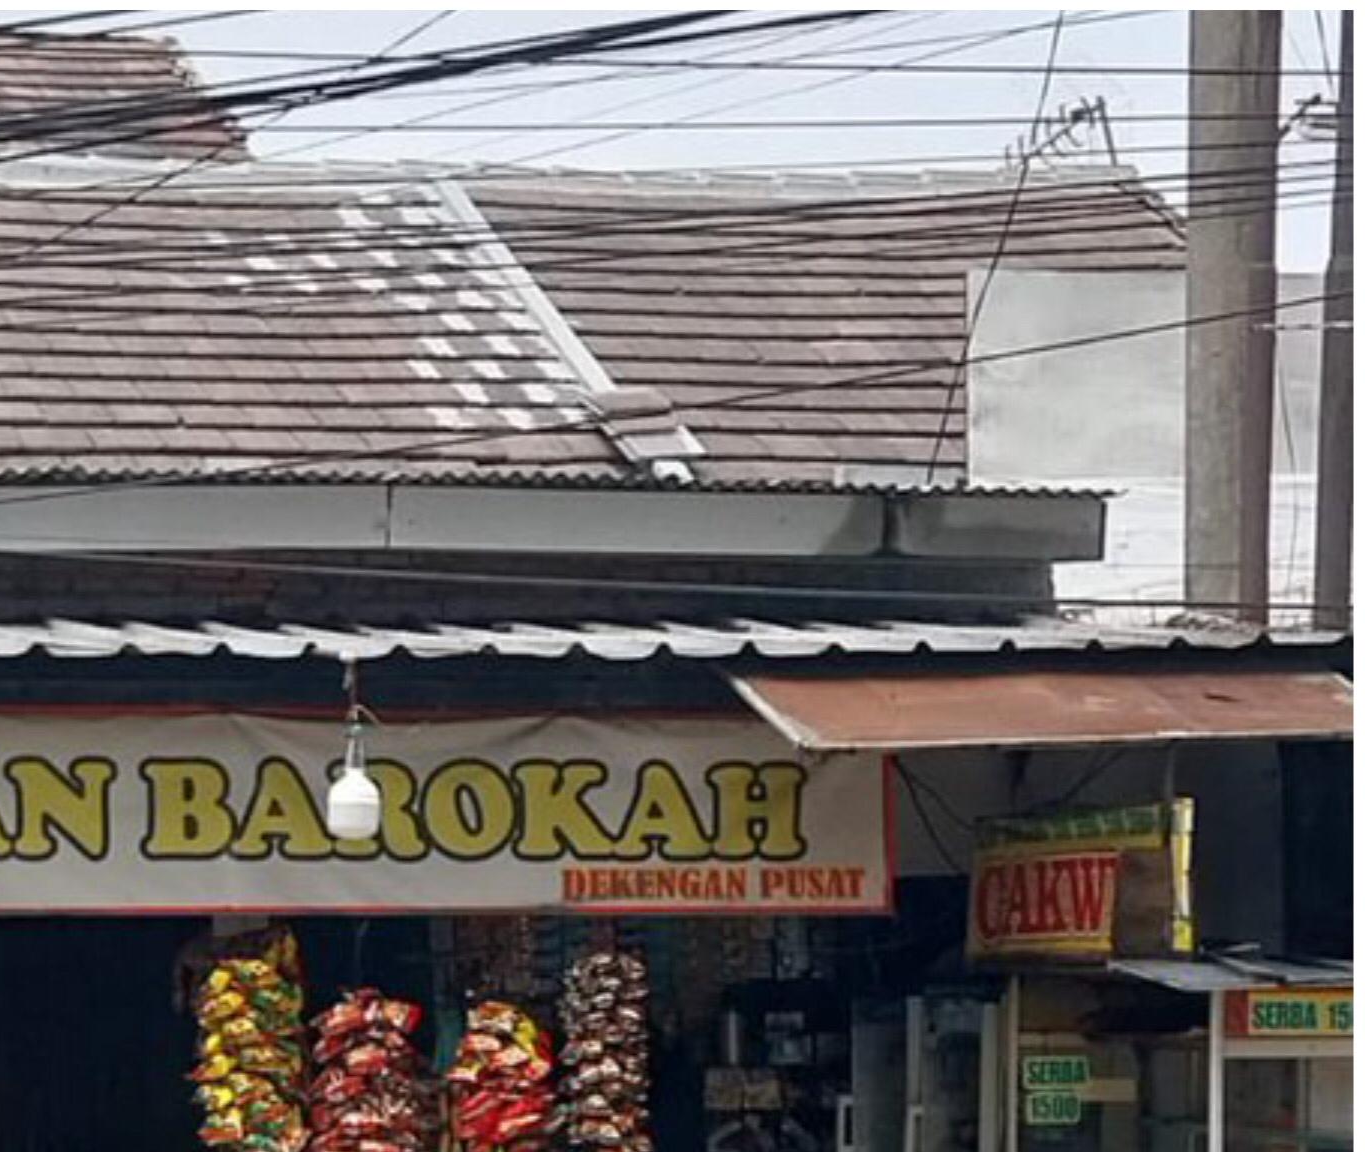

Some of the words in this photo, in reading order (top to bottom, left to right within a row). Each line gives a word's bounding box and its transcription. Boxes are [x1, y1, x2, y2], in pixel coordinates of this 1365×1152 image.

[139, 755, 807, 862] BAROKAH
[562, 868, 748, 899] DEKENGAN
[761, 867, 867, 897] PUSAT
[1251, 1000, 1317, 1029] SERBA
